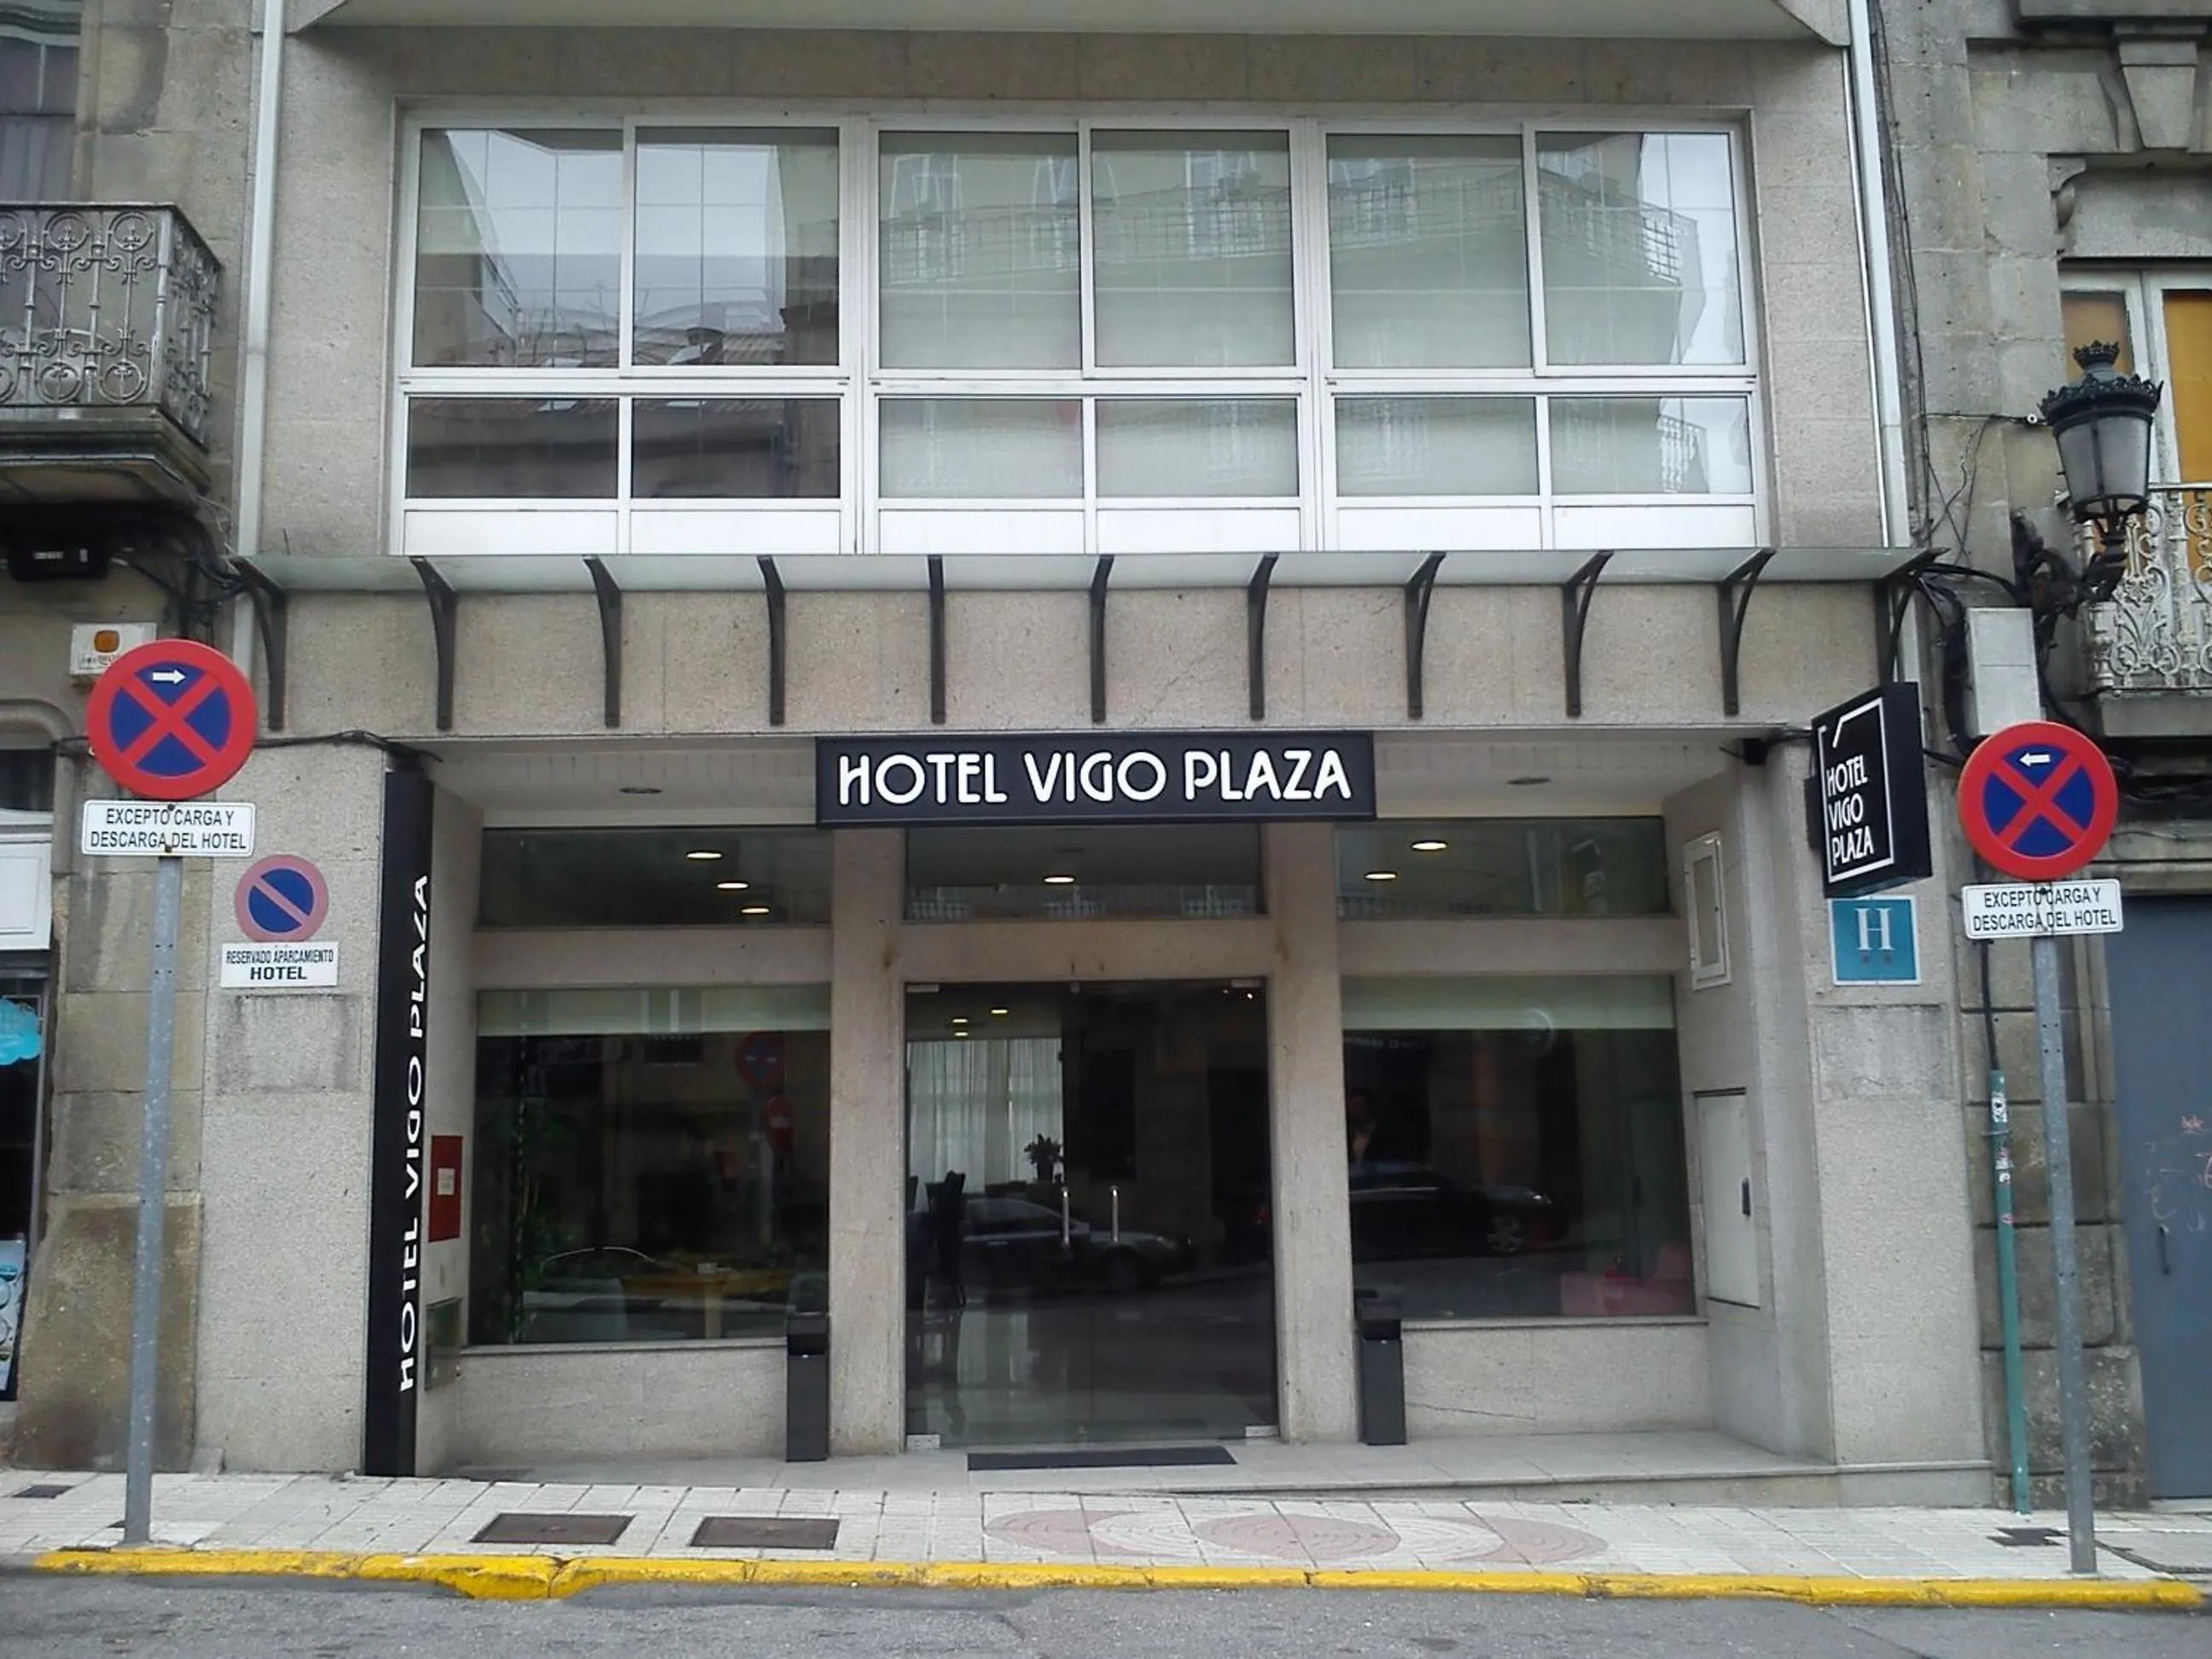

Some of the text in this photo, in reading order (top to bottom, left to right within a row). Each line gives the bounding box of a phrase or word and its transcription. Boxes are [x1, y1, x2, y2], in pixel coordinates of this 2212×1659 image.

[839, 749, 1352, 805] HOTEL VIGO PLAZA
[1826, 754, 1868, 797] HOTEL
[106, 808, 235, 827] EXCEPTO CARGA Y
[1829, 792, 1864, 831] VIGO
[90, 830, 247, 849] DESCARGA DEL HOTEL
[1831, 825, 1873, 866] PLAZA
[1984, 887, 2102, 908] EXCEPTO CARGA Y
[1854, 907, 1895, 951] H
[1973, 909, 2116, 932] DESCARGA DEL HOTEL
[226, 949, 334, 964] RESERVADO APARCAMIENTO
[250, 966, 307, 980] HOTEL
[400, 876, 428, 1392] HOTEL VIGO PLAZA
